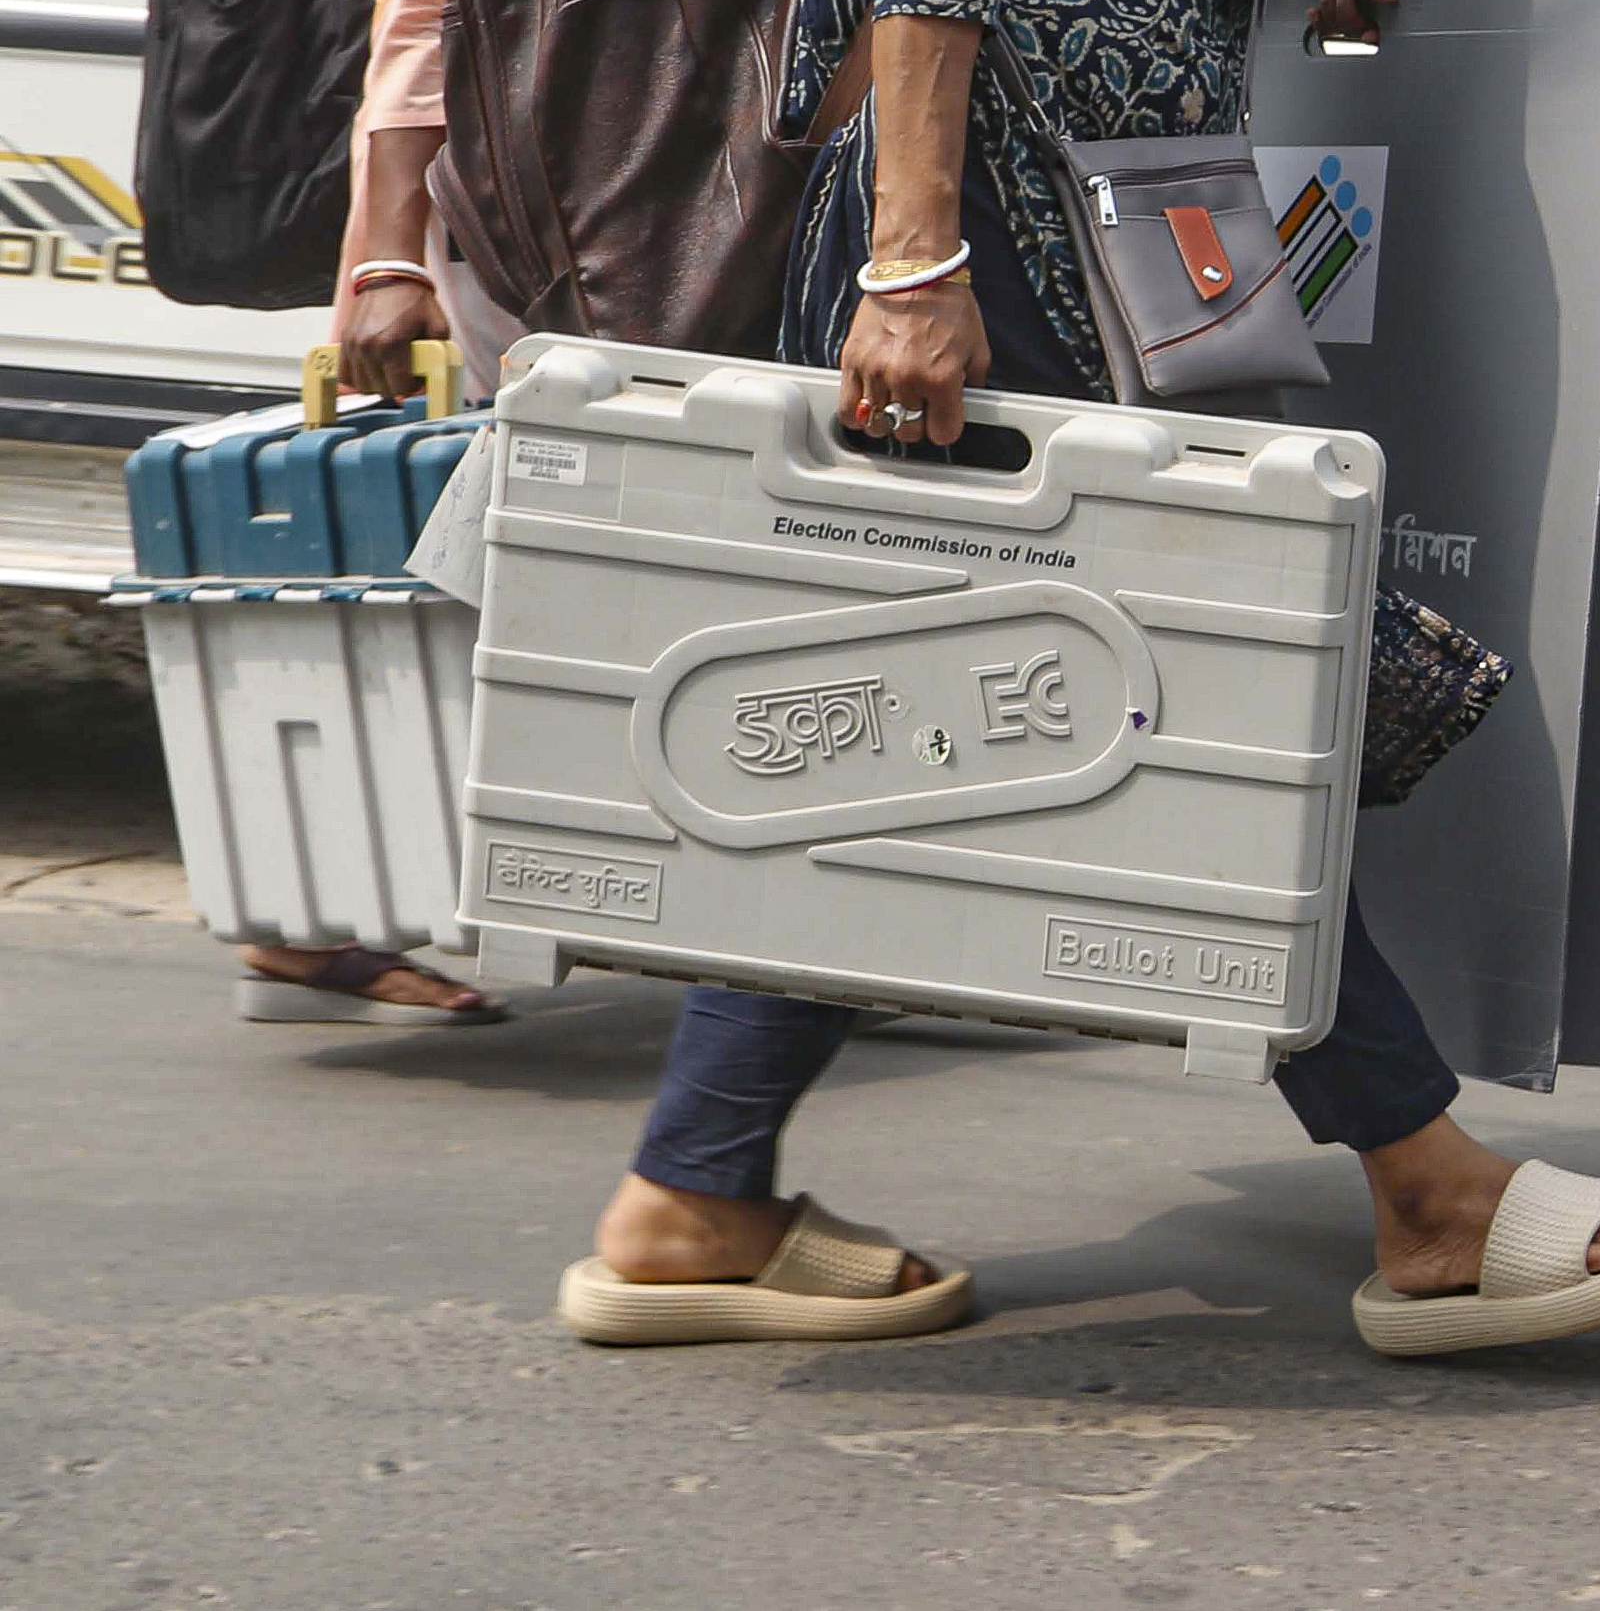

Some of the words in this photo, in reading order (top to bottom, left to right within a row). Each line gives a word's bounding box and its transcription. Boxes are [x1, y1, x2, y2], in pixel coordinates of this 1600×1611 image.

[772, 516, 857, 544] Election
[863, 527, 992, 559] Commission
[999, 546, 1023, 562] of
[1025, 547, 1077, 570] India
[1382, 513, 1478, 579] মিশন
[1057, 930, 1175, 978] Ballot
[1197, 947, 1275, 991] Unit
